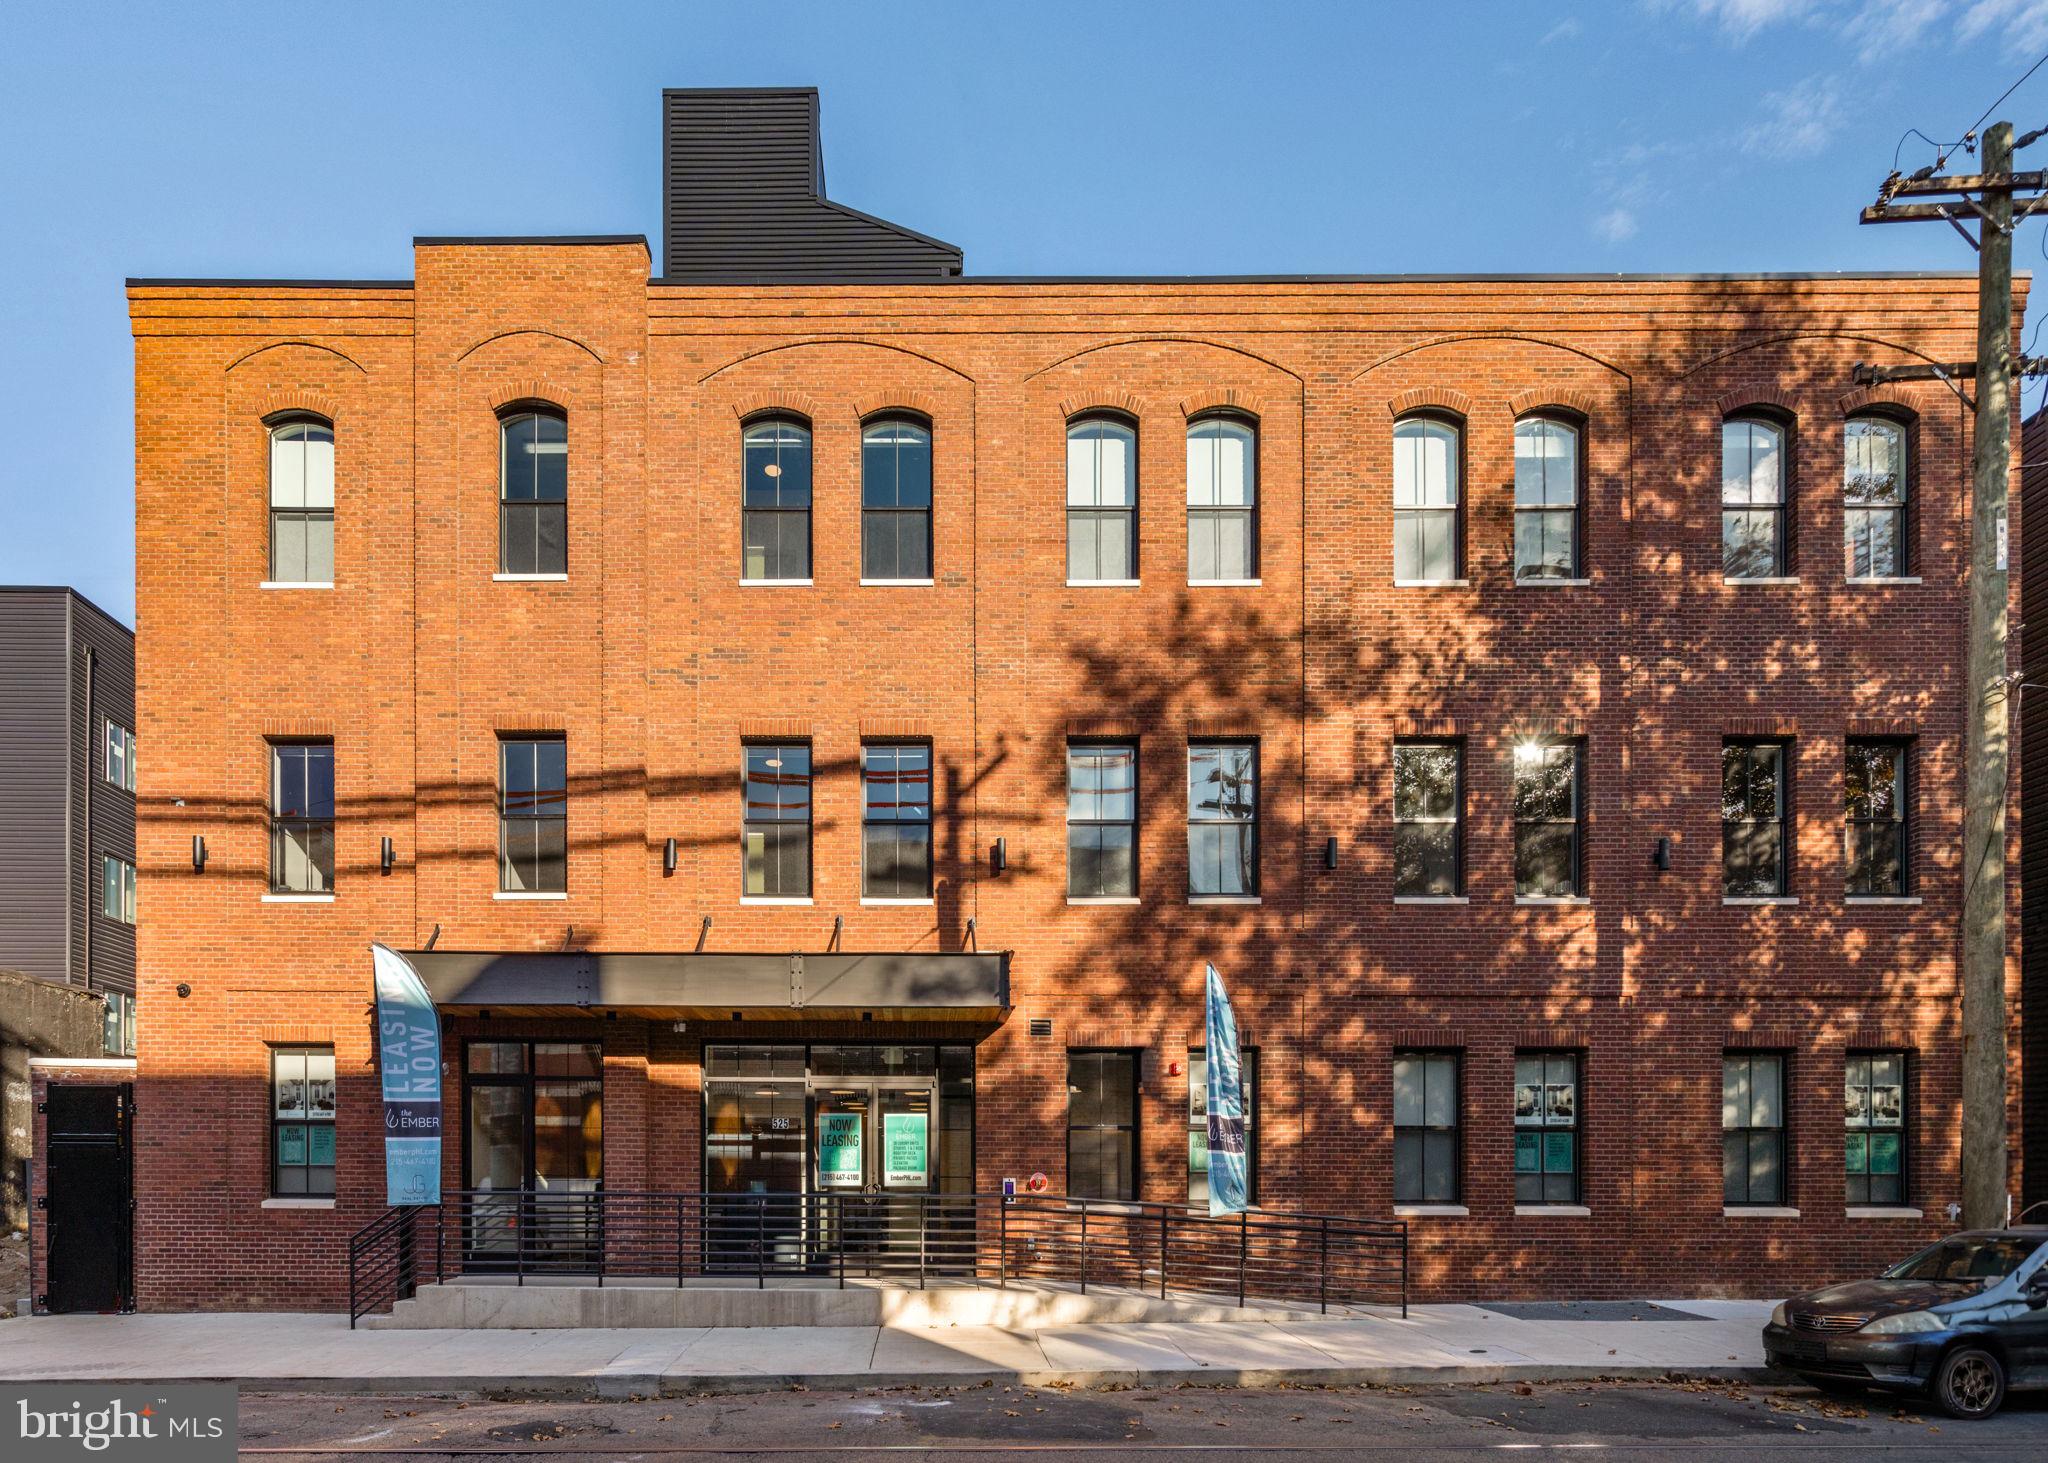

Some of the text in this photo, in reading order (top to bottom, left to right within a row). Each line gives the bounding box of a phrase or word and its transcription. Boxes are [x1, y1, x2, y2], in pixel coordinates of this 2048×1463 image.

[381, 966, 410, 1093] LEASIN
[409, 1026, 437, 1092] NOW
[401, 1109, 412, 1117] the
[401, 1117, 440, 1128] EMBER
[773, 1118, 789, 1129] 525
[829, 1119, 852, 1132] NOW
[281, 1134, 304, 1142] LEASING
[822, 1134, 859, 1147] LEASING
[836, 1173, 860, 1181] 467-4100
